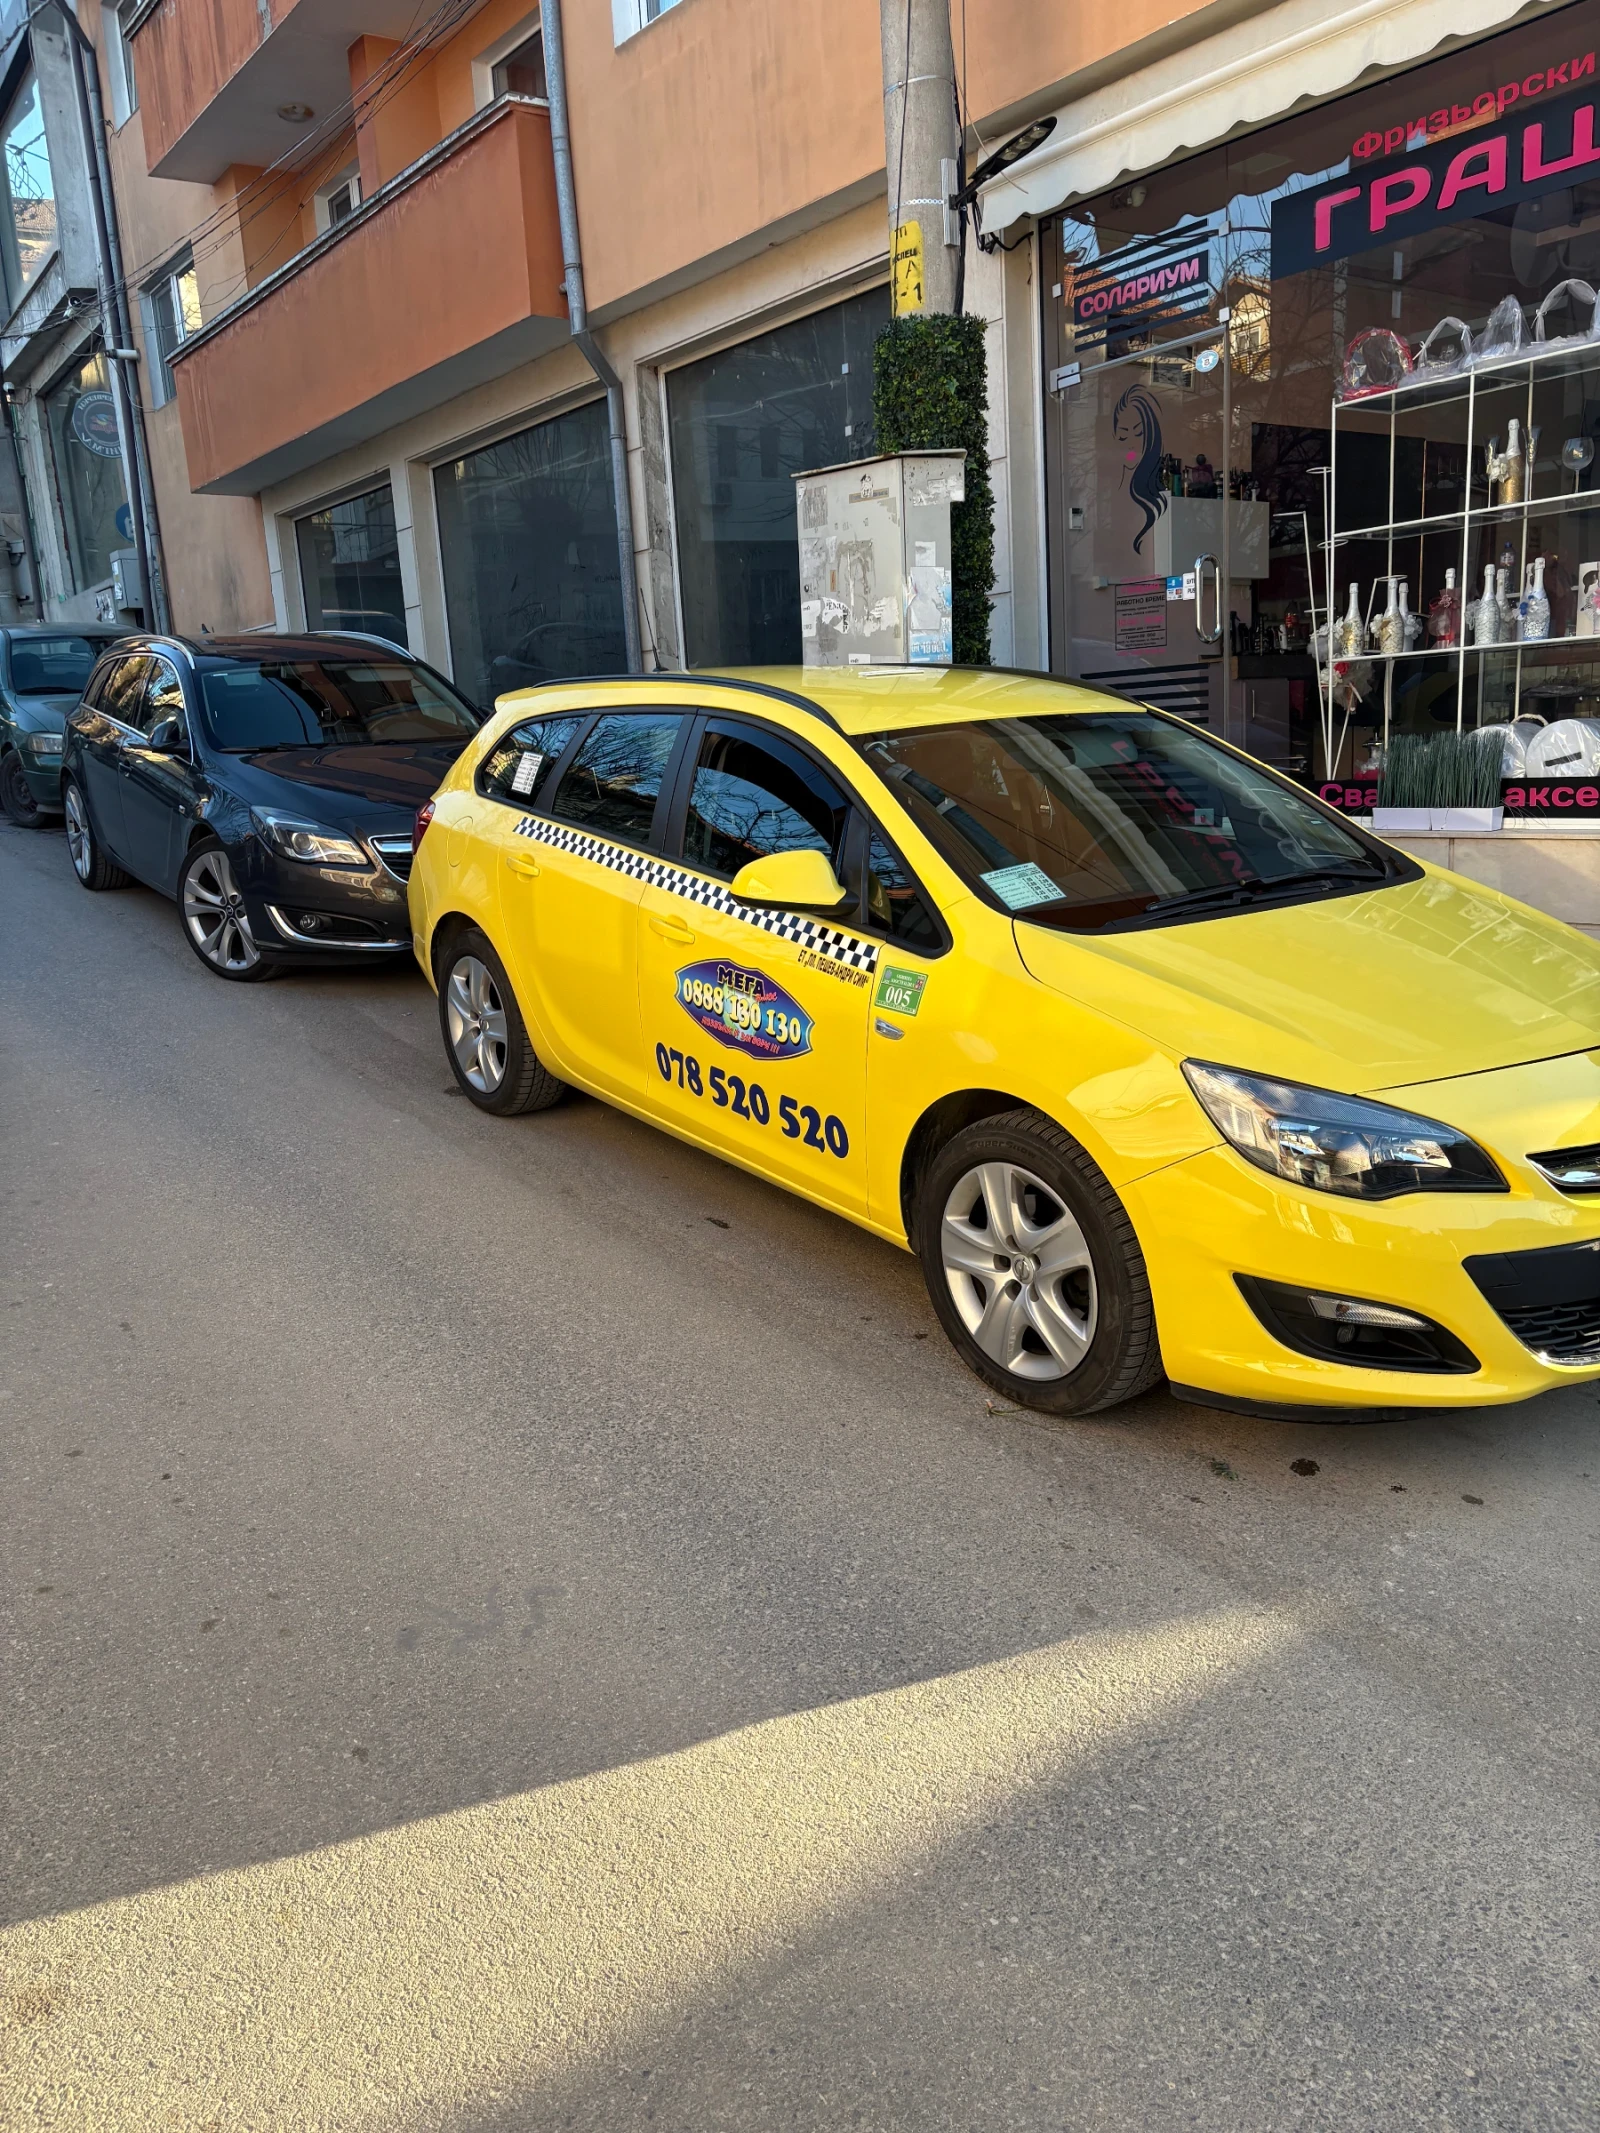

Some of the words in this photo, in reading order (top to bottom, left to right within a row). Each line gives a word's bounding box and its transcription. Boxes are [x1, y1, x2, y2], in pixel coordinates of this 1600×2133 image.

[1352, 52, 1596, 158] Фризьорски
[1080, 257, 1199, 318] СОЛАРИУМ
[1116, 596, 1144, 606] РАБОТНО
[1145, 595, 1166, 603] ВРЕМЕ
[1505, 785, 1600, 808] аксе
[717, 965, 765, 997] МЕГА
[886, 985, 912, 1008] 005
[683, 978, 724, 1015] 0888
[727, 995, 761, 1029] 130
[765, 1009, 801, 1044] 130
[656, 1042, 703, 1097] 078
[709, 1065, 770, 1125] 520
[779, 1094, 849, 1158] 520
